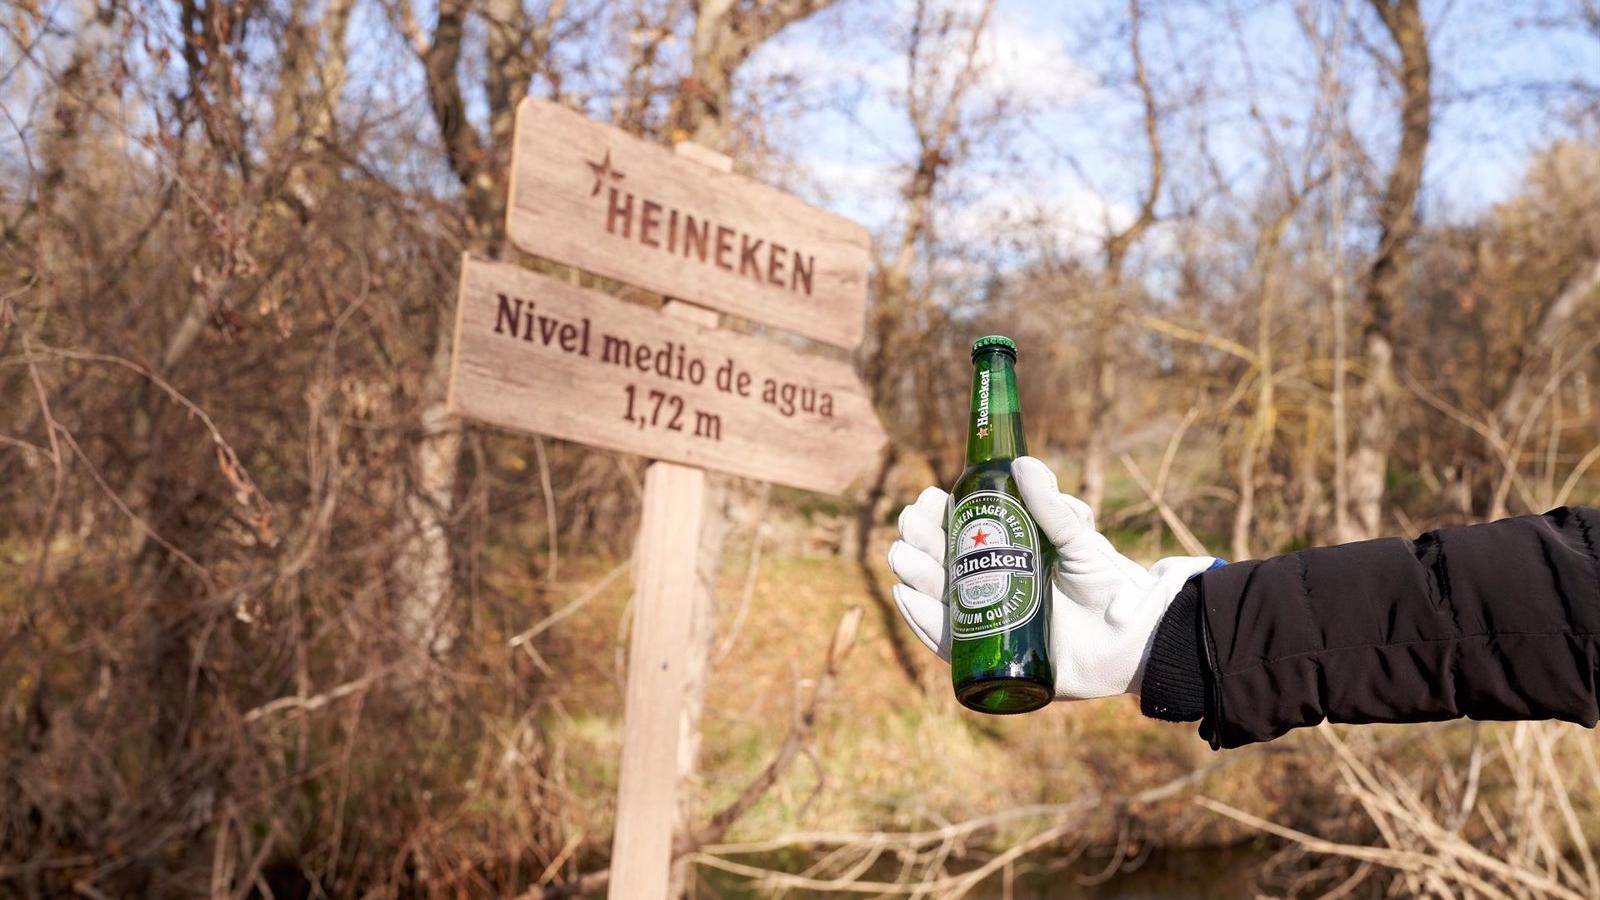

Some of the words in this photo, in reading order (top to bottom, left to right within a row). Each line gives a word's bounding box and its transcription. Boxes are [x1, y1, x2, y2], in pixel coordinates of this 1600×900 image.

[605, 184, 815, 296] HEINEKEN
[494, 292, 590, 357] Nivel
[601, 334, 705, 386] medio
[716, 358, 752, 397] de
[762, 378, 834, 418] agua
[623, 383, 685, 432] 1,72
[694, 409, 722, 441] m
[977, 369, 990, 427] Heineken
[975, 505, 1007, 519] LAGER
[1005, 515, 1024, 539] BEER
[986, 588, 1026, 621] QUALITY
